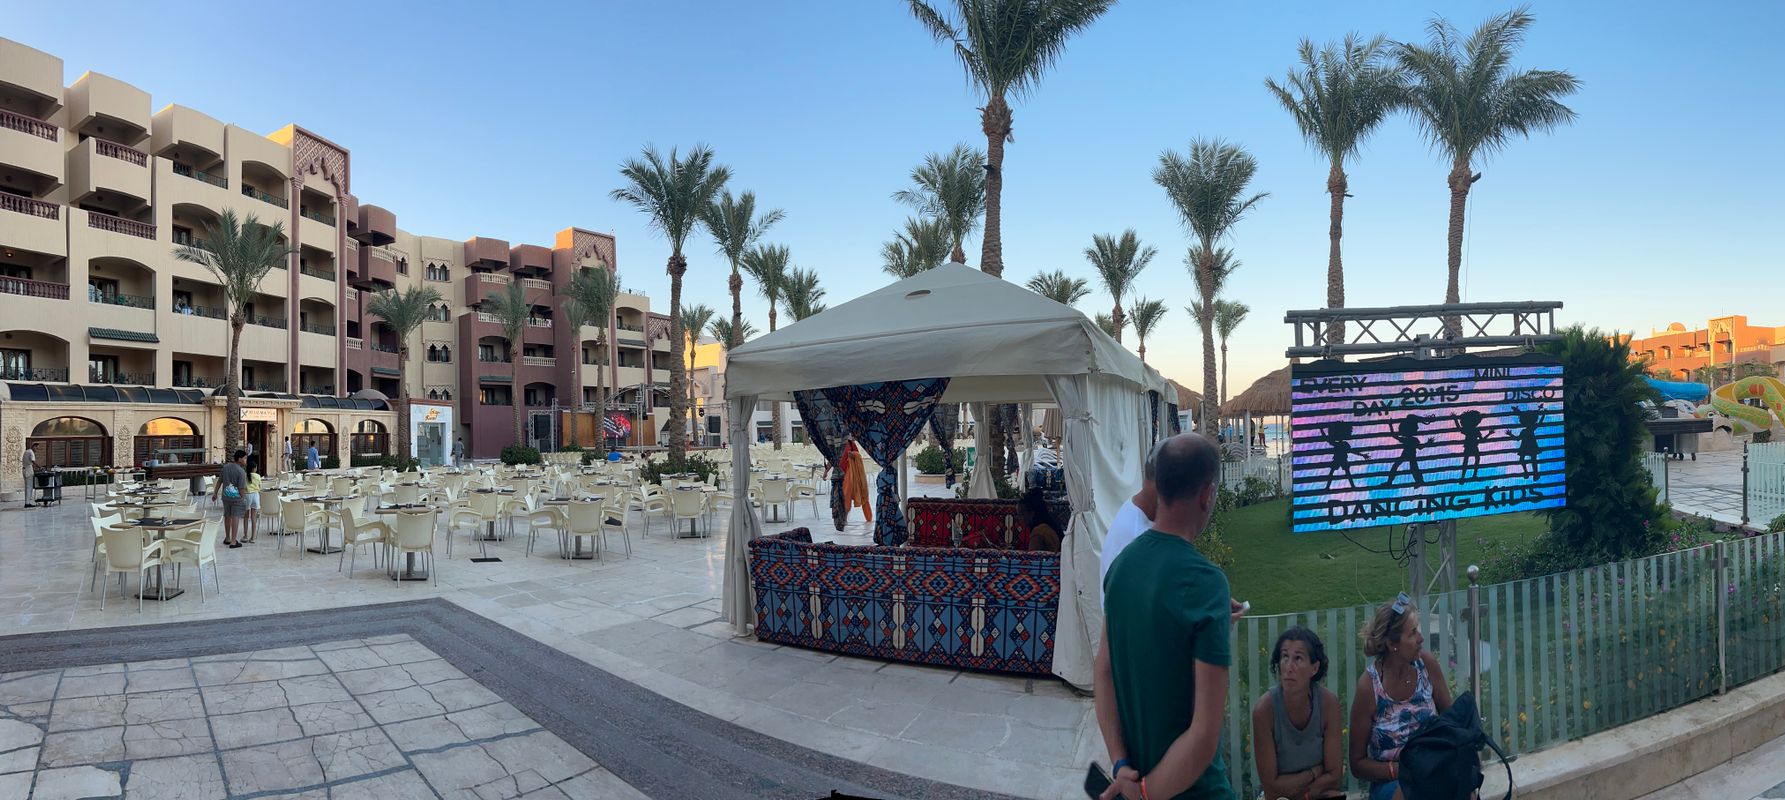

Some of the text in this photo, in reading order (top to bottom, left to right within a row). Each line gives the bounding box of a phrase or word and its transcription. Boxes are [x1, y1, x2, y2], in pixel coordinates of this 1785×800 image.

[1475, 367, 1510, 379] MINI
[1401, 385, 1458, 406] 20:15
[1505, 387, 1555, 401] DISCO
[1353, 400, 1393, 417] DAY
